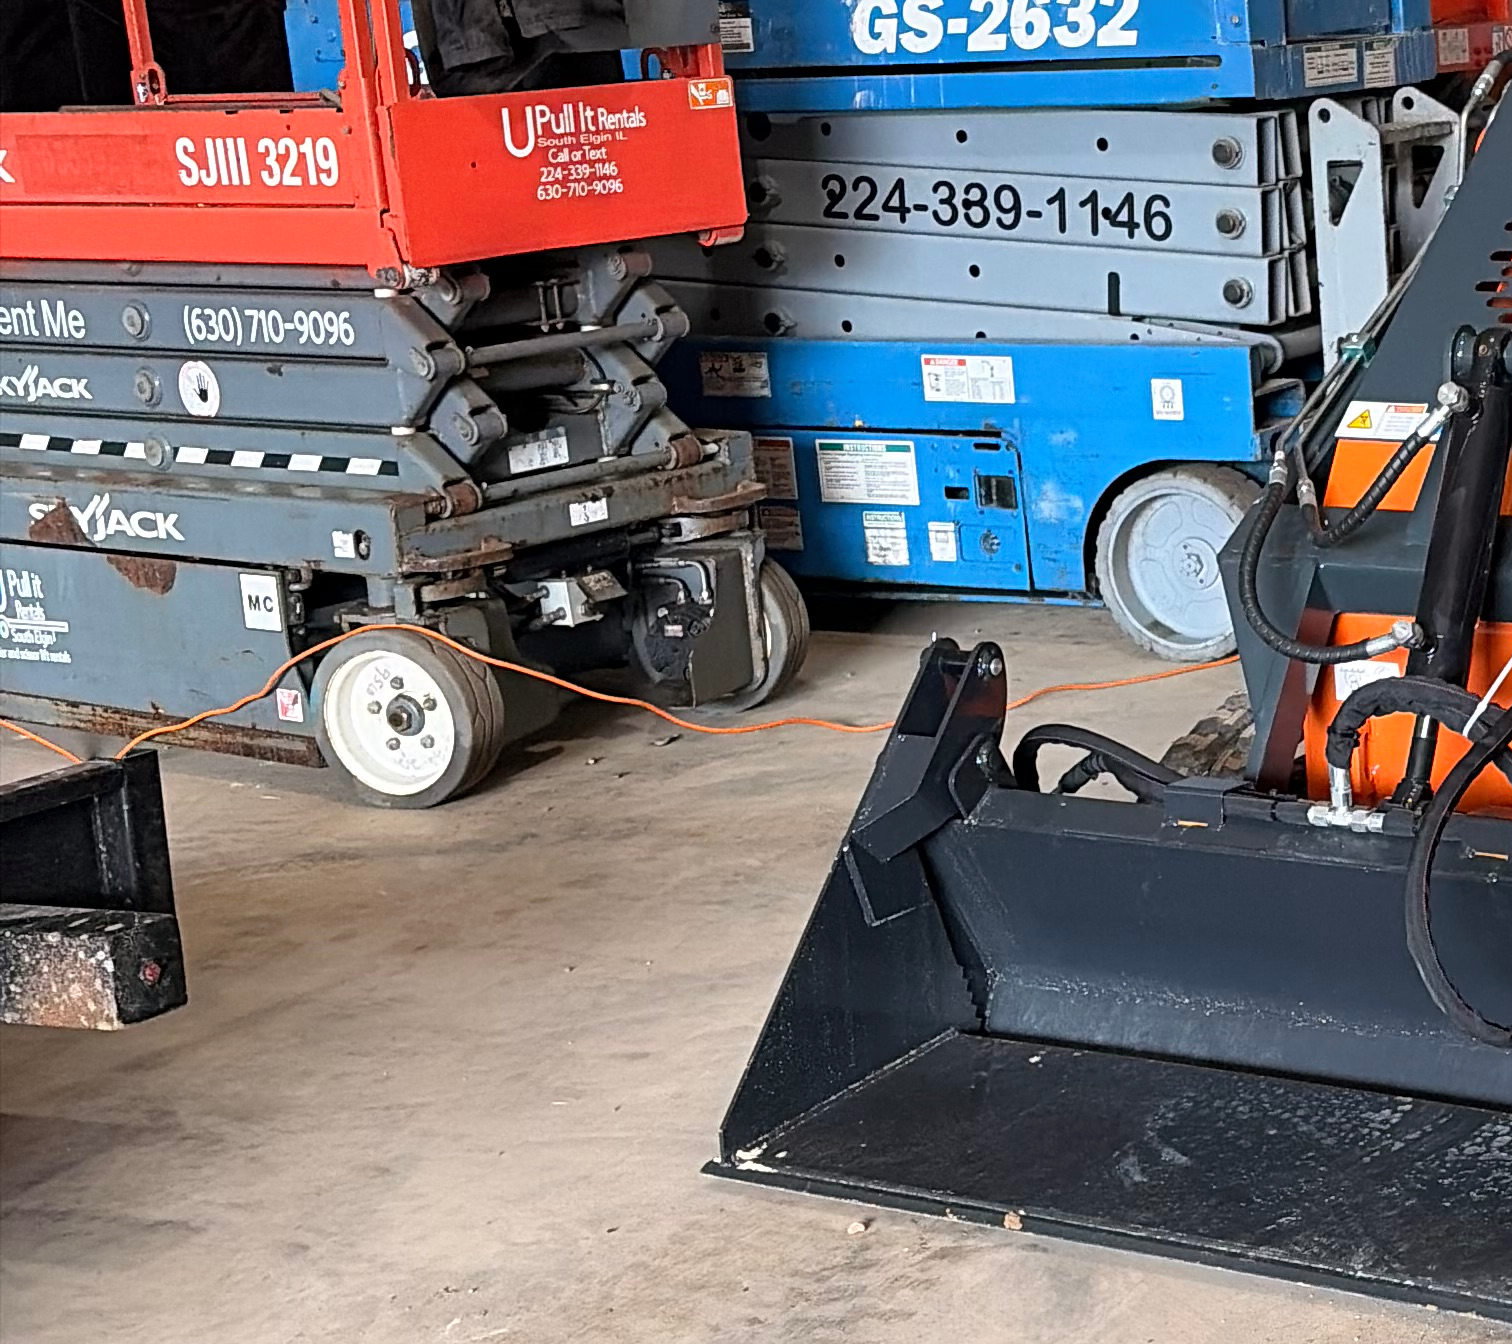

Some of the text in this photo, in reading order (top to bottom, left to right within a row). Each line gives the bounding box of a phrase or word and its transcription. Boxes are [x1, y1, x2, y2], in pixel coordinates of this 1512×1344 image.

[501, 101, 647, 158] U Pull It Rentals
[537, 131, 628, 147] South Elgin IL
[175, 137, 339, 186] SJIII 3219
[548, 146, 607, 163] Call or Text
[540, 162, 618, 182] 224-339-1146
[537, 179, 624, 200] 630-710-9096
[821, 173, 1173, 242] 224-339-1146
[41, 299, 86, 339] Me
[183, 305, 355, 346] (630) 710-9096
[28, 492, 186, 543] SYJACK
[6, 569, 32, 597] Pull
[248, 594, 274, 613] MC
